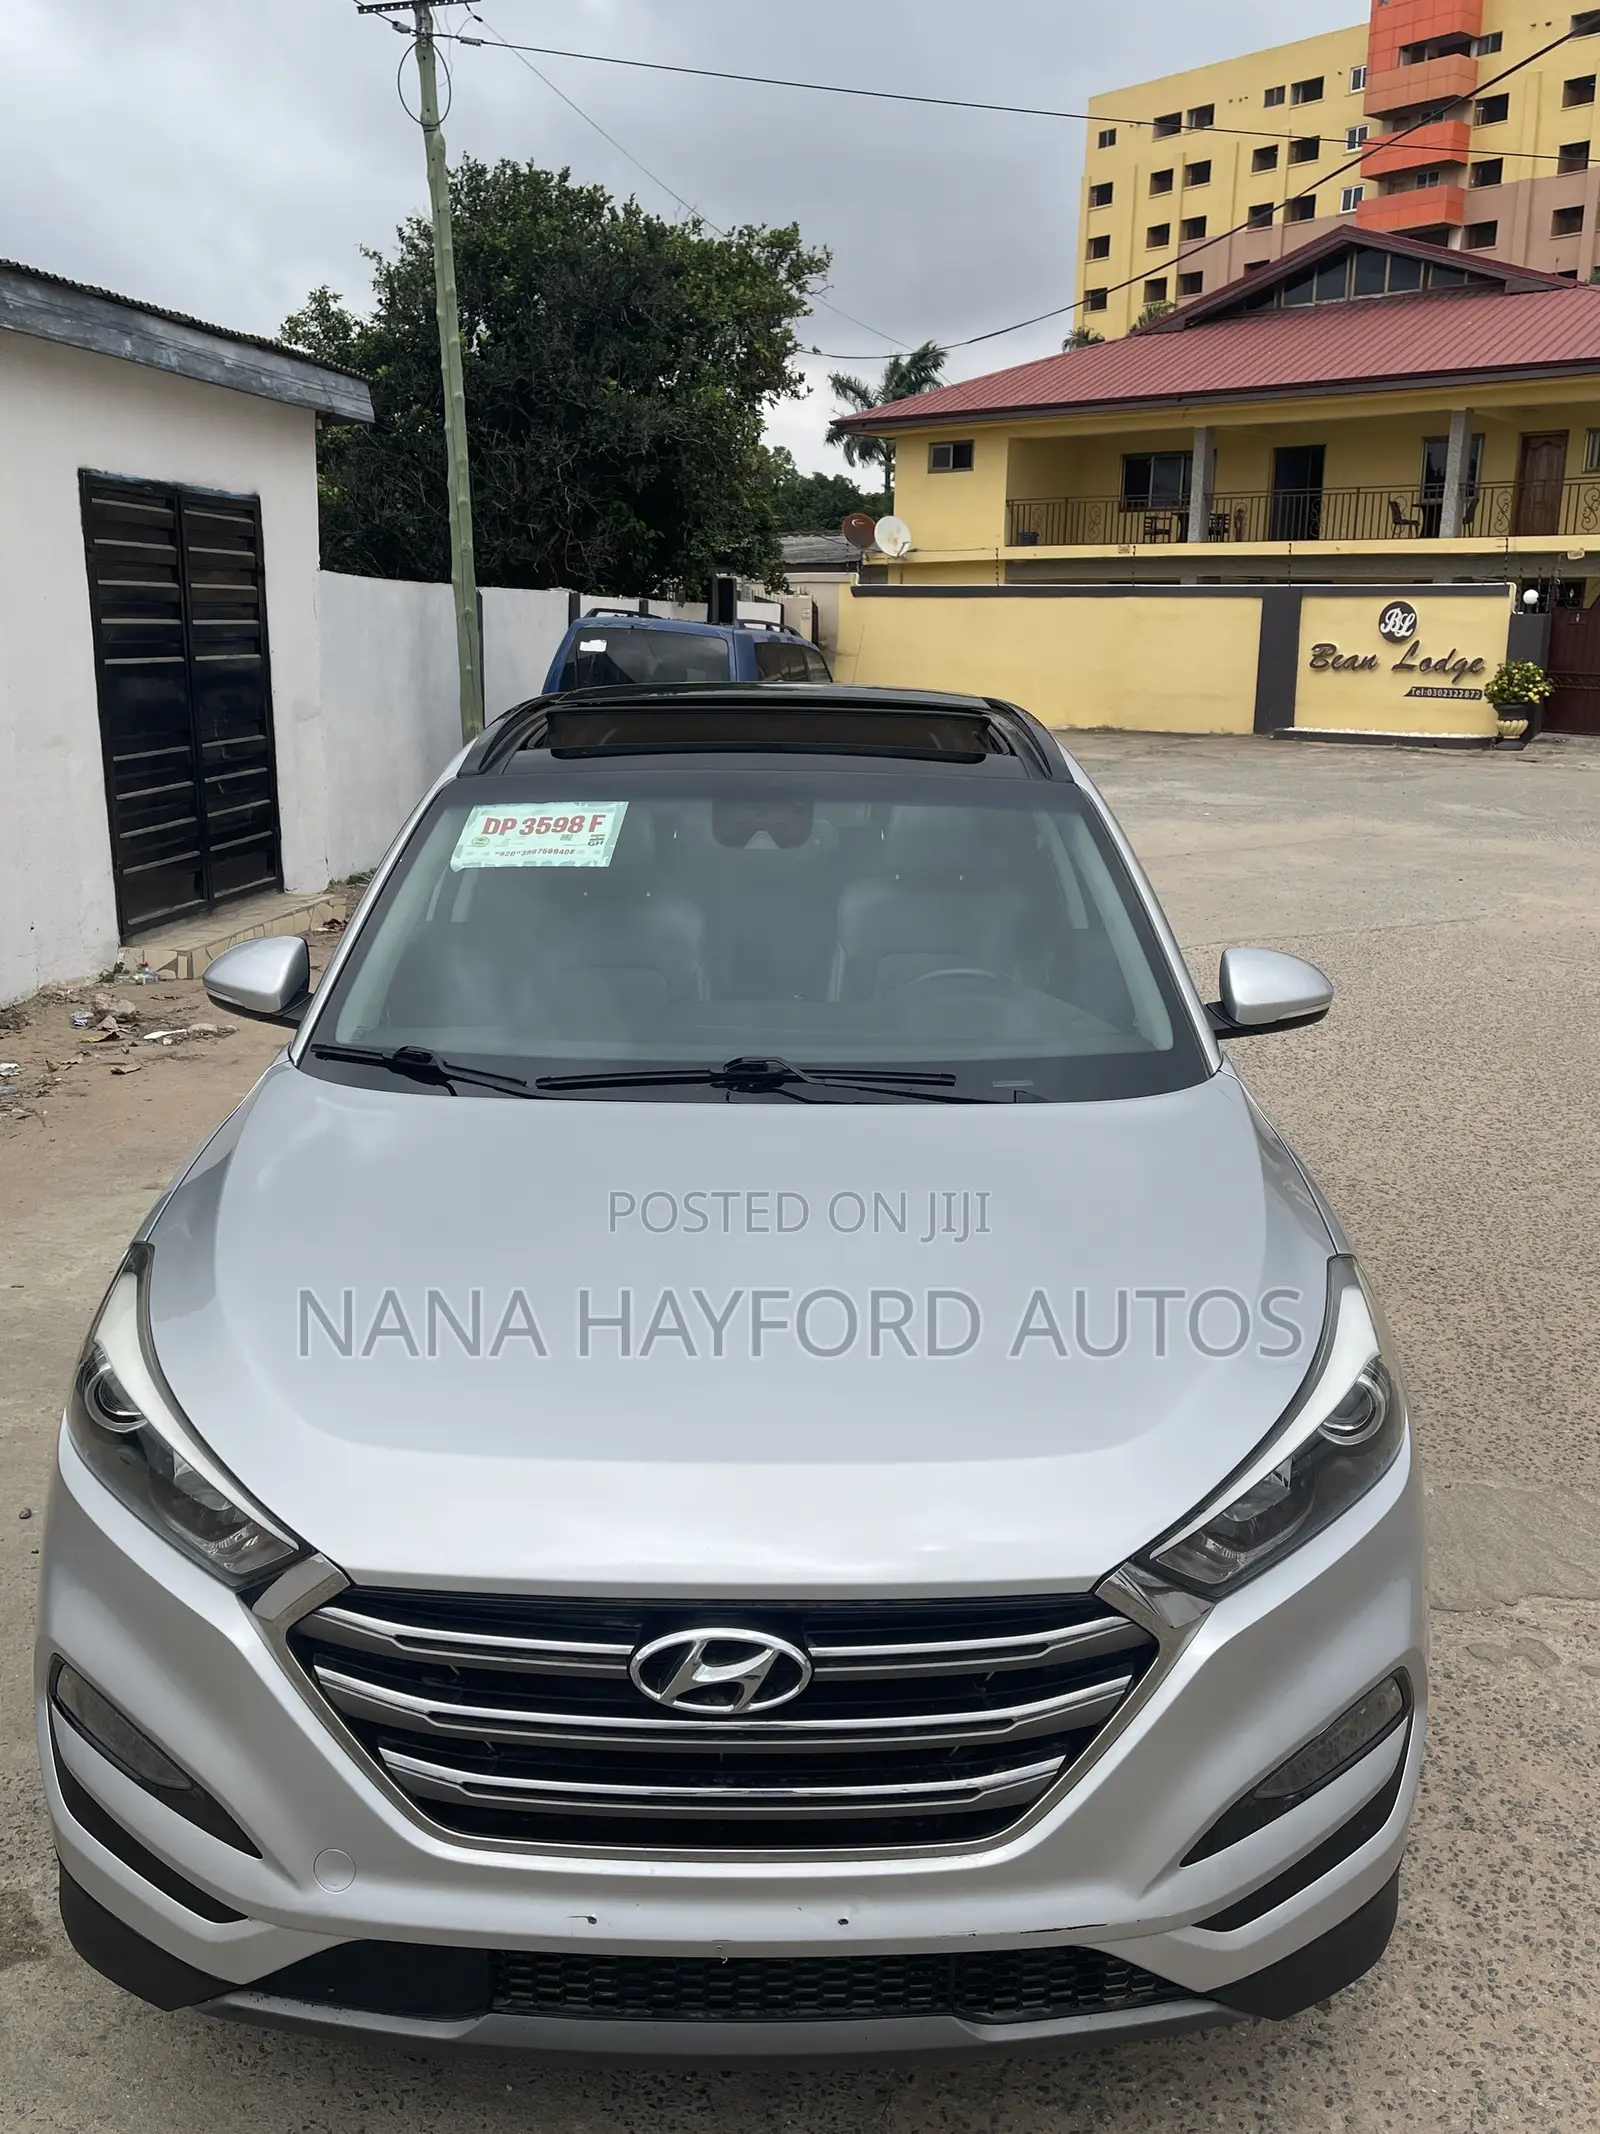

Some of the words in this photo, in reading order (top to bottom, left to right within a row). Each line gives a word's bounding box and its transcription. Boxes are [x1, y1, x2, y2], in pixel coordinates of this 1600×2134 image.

[1309, 643, 1378, 671] Bean
[1391, 639, 1485, 683] Lodge
[481, 817, 517, 835] DP
[519, 815, 586, 835] 3598
[588, 814, 606, 833] F
